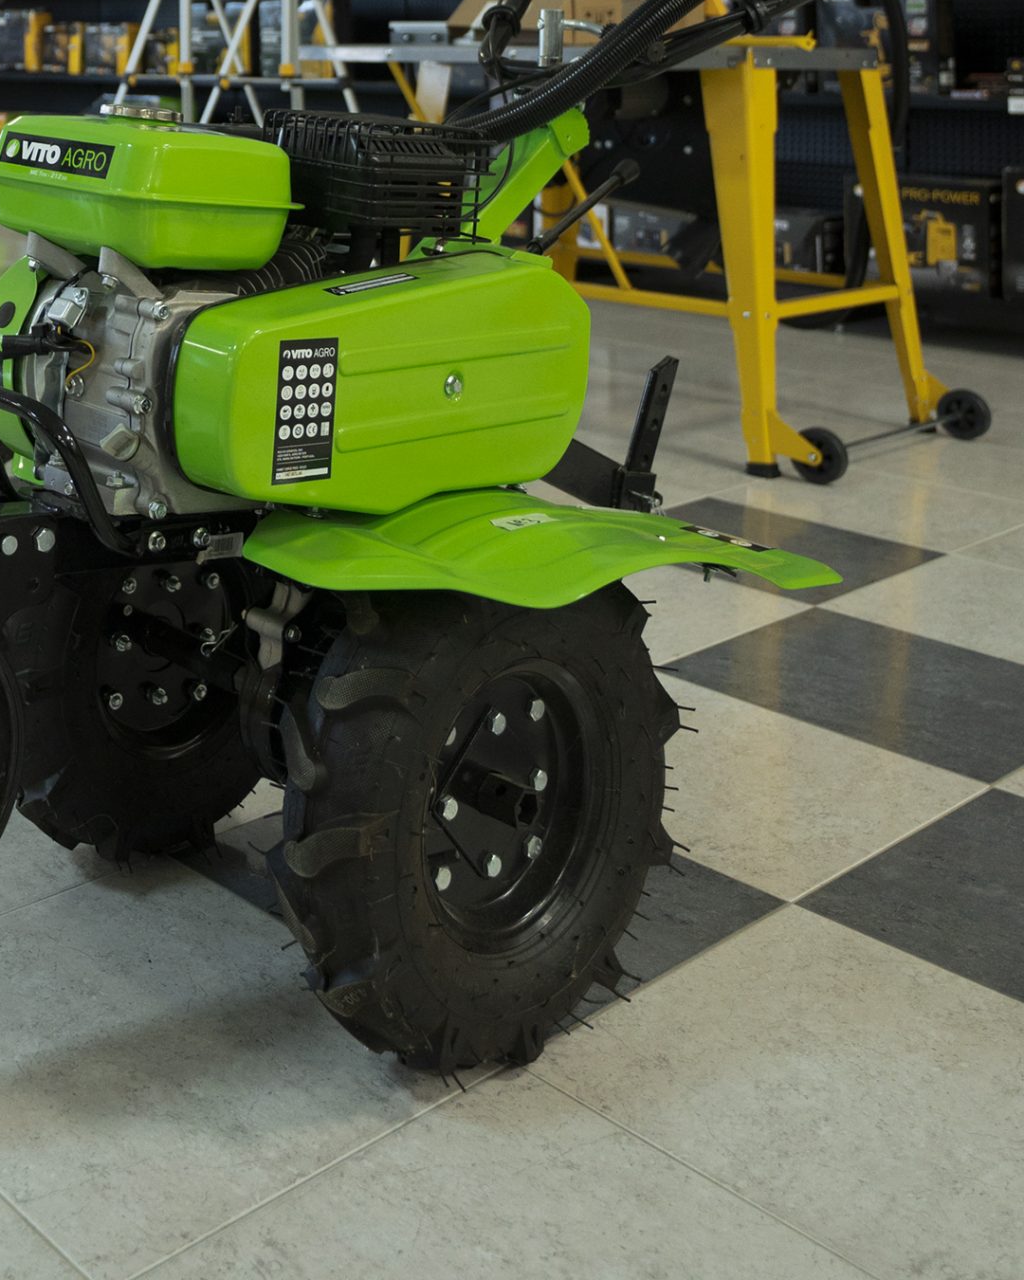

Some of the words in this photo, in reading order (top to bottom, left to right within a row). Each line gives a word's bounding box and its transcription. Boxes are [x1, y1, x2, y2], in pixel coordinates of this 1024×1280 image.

[22, 140, 62, 165] VITO
[61, 147, 107, 172] AGRO
[291, 348, 313, 359] VITO
[314, 347, 336, 358] AGRO
